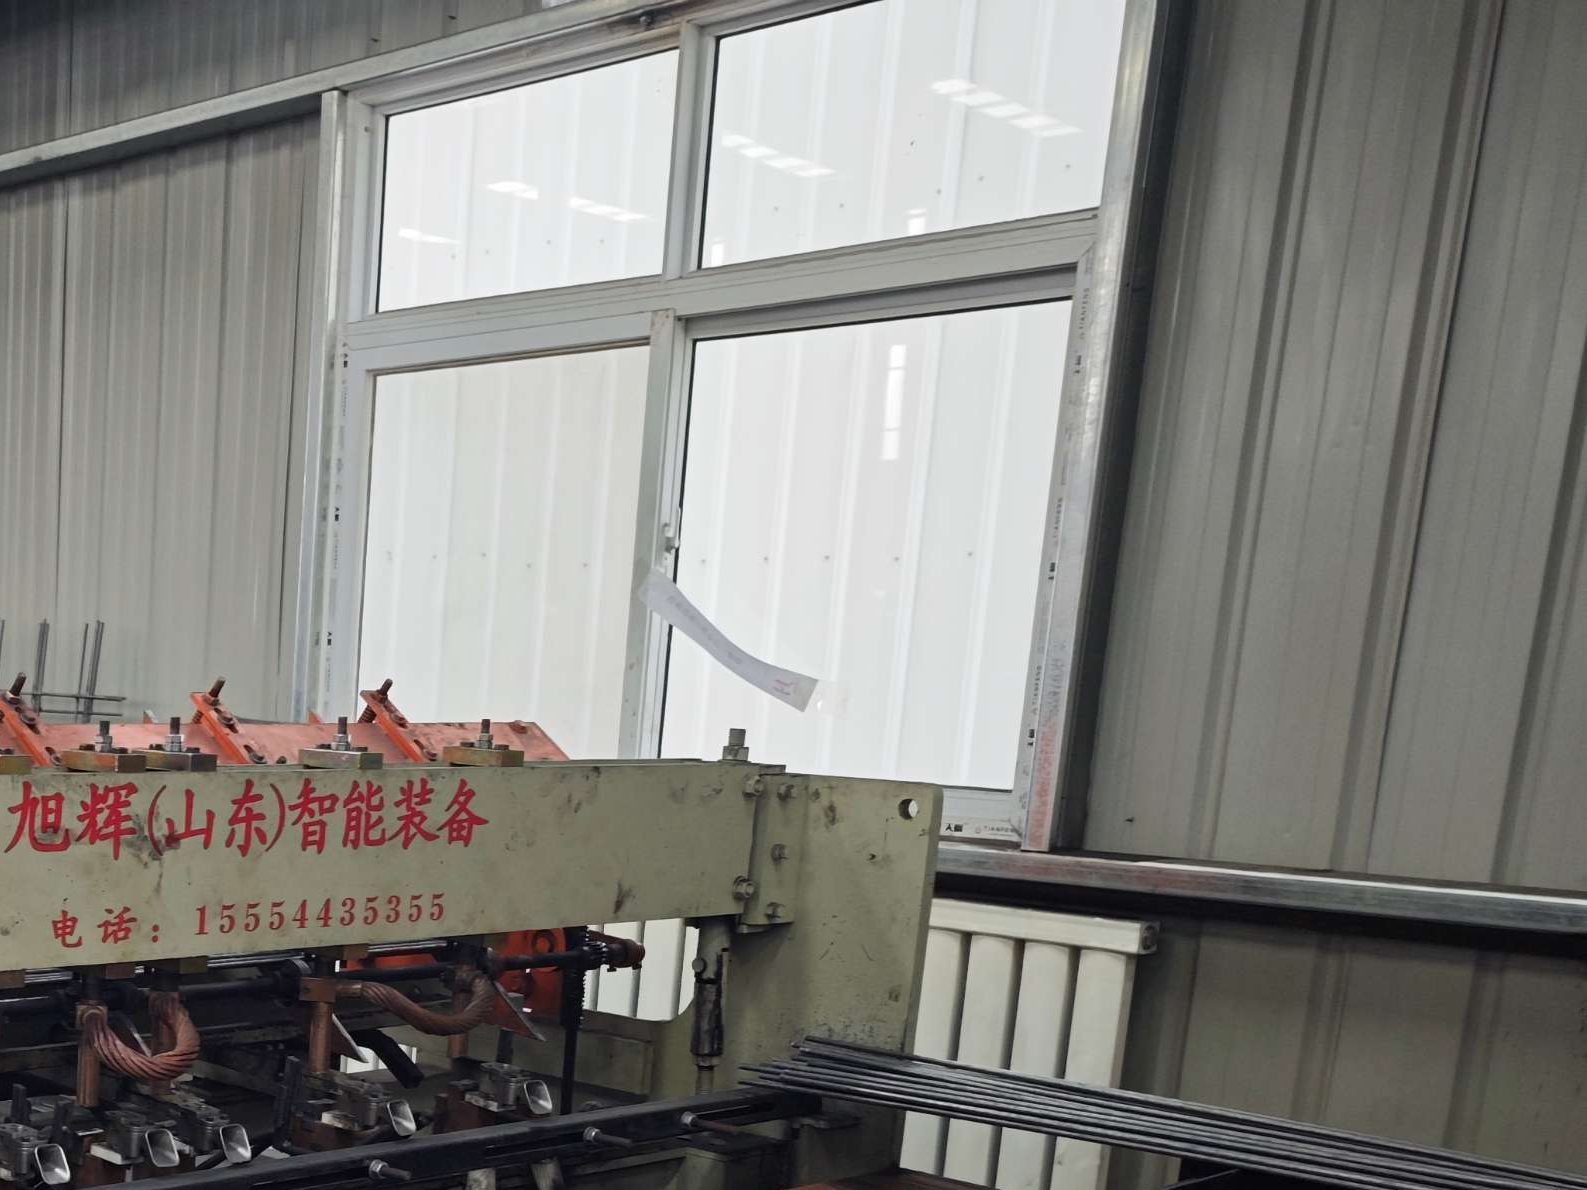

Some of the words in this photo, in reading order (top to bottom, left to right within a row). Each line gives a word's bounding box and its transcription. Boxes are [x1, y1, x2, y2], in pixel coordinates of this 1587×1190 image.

[4, 778, 489, 860] 旭辉(山东)智能装备
[194, 892, 446, 936] 15554435355
